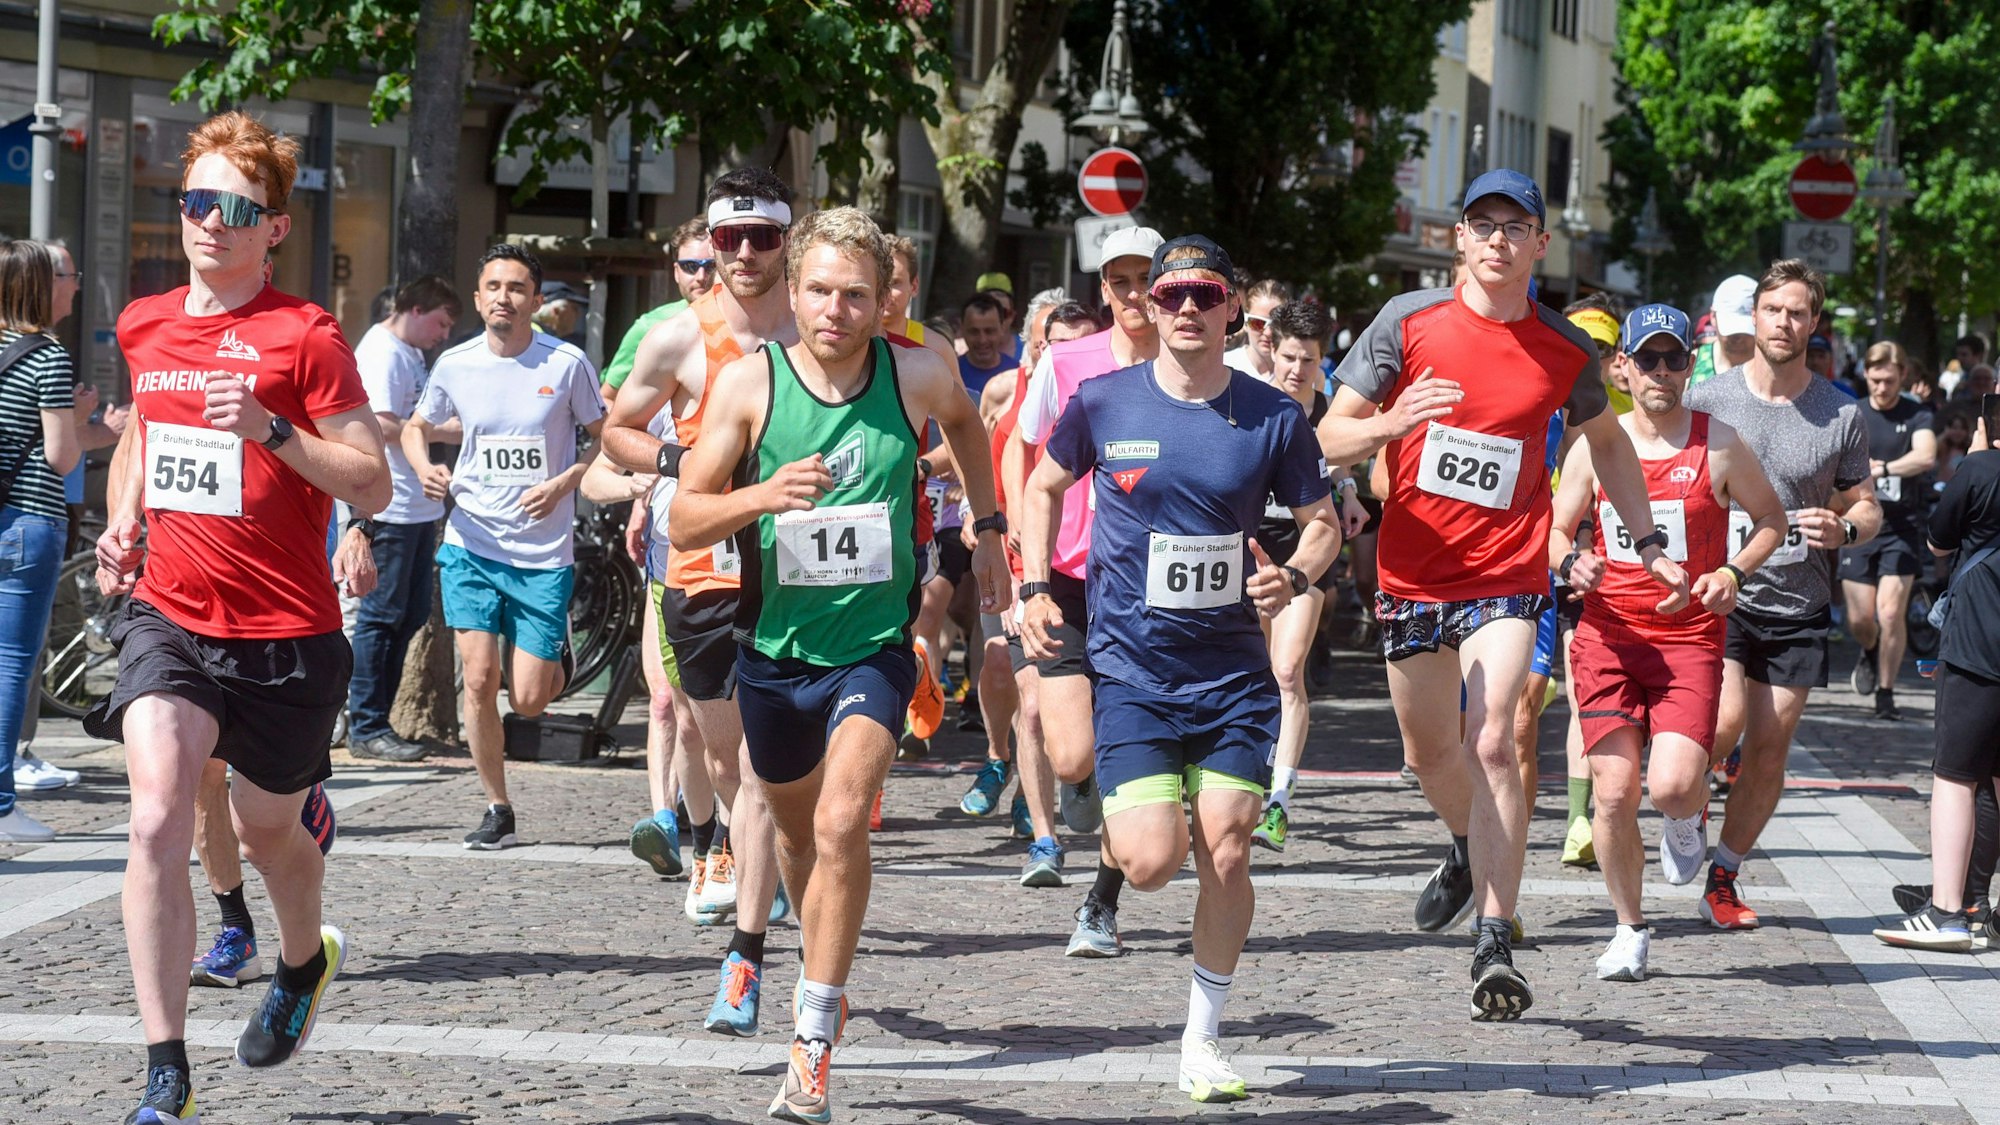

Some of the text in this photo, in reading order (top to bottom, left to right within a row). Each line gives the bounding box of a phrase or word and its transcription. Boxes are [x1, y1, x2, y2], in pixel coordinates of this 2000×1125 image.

[163, 434, 235, 450] Brühler Stadtlauf
[1447, 435, 1516, 454] Brühler Stadtlauf
[482, 448, 542, 470] 1036
[154, 454, 219, 496] 554
[1120, 474, 1135, 485] PT
[1437, 452, 1501, 491] 626
[811, 526, 859, 562] 14
[1172, 541, 1239, 552] Brühler Stadtlauf
[1616, 524, 1669, 549] 56
[1167, 561, 1229, 592] 619
